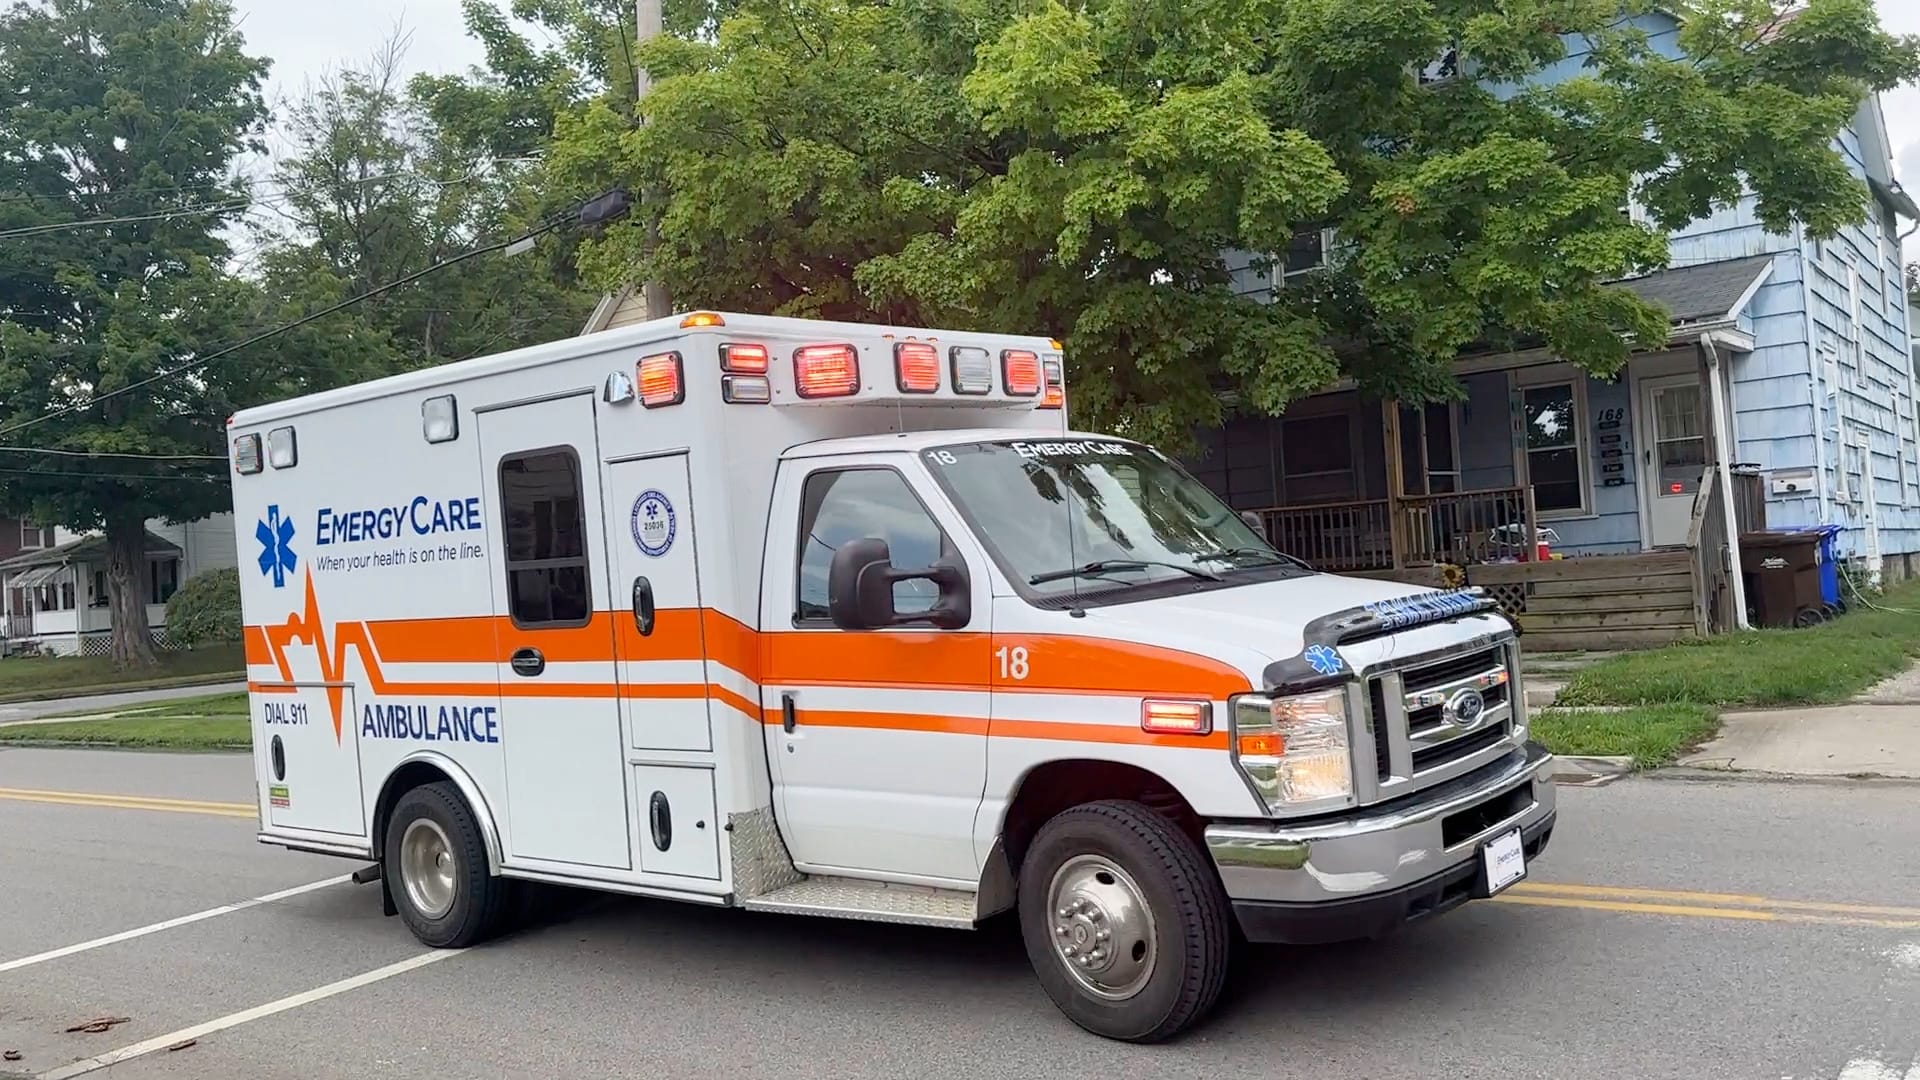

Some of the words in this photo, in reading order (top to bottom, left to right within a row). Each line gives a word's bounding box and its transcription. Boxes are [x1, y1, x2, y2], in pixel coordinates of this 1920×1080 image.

[1597, 408, 1624, 421] 168
[927, 450, 957, 466] 18
[316, 555, 345, 571] When
[347, 555, 371, 573] your
[373, 547, 406, 567] health
[409, 547, 418, 564] is
[420, 549, 435, 562] on
[438, 544, 457, 561] the
[459, 541, 484, 559] line.
[995, 645, 1030, 680] 18
[264, 702, 290, 724] DIAL
[290, 703, 308, 725] 911
[362, 704, 499, 743] AMBULANCE
